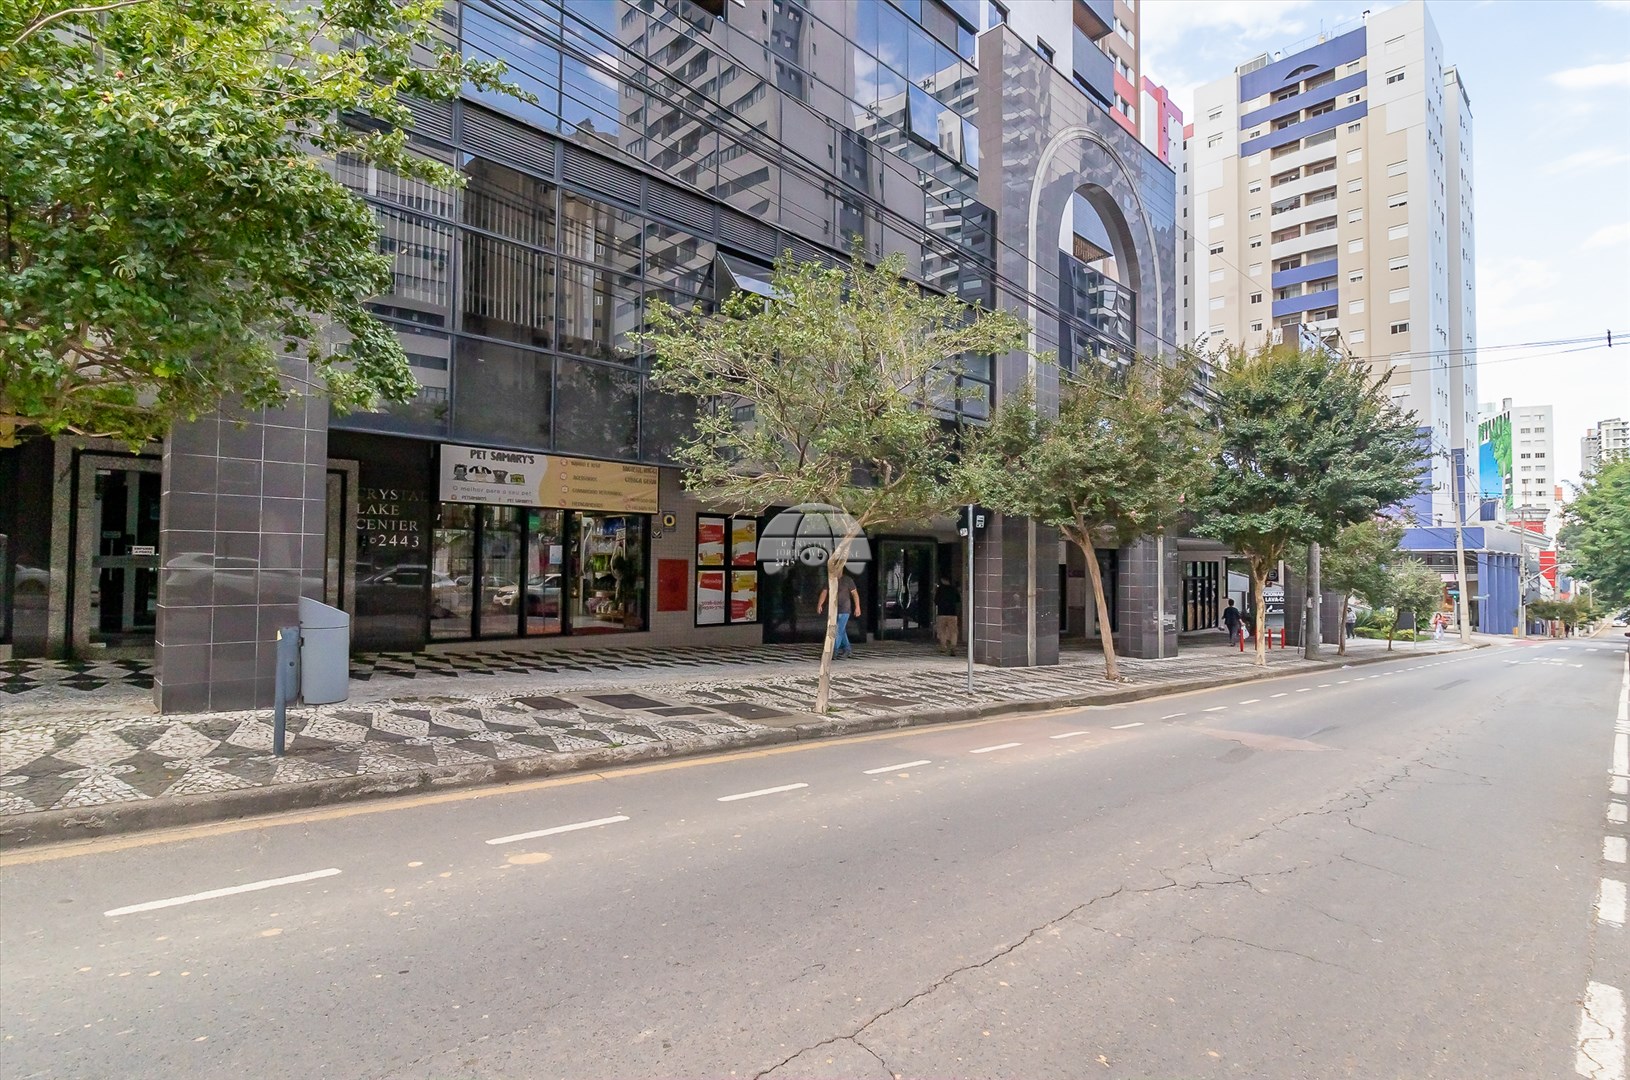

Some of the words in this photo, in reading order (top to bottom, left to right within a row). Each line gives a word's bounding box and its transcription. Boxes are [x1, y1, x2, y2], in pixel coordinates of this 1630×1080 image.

[470, 449, 487, 460] PET
[491, 451, 535, 464] SAMARY'S
[357, 503, 400, 515] LAKE
[356, 518, 418, 531] CENTER
[378, 534, 419, 548] 2443
